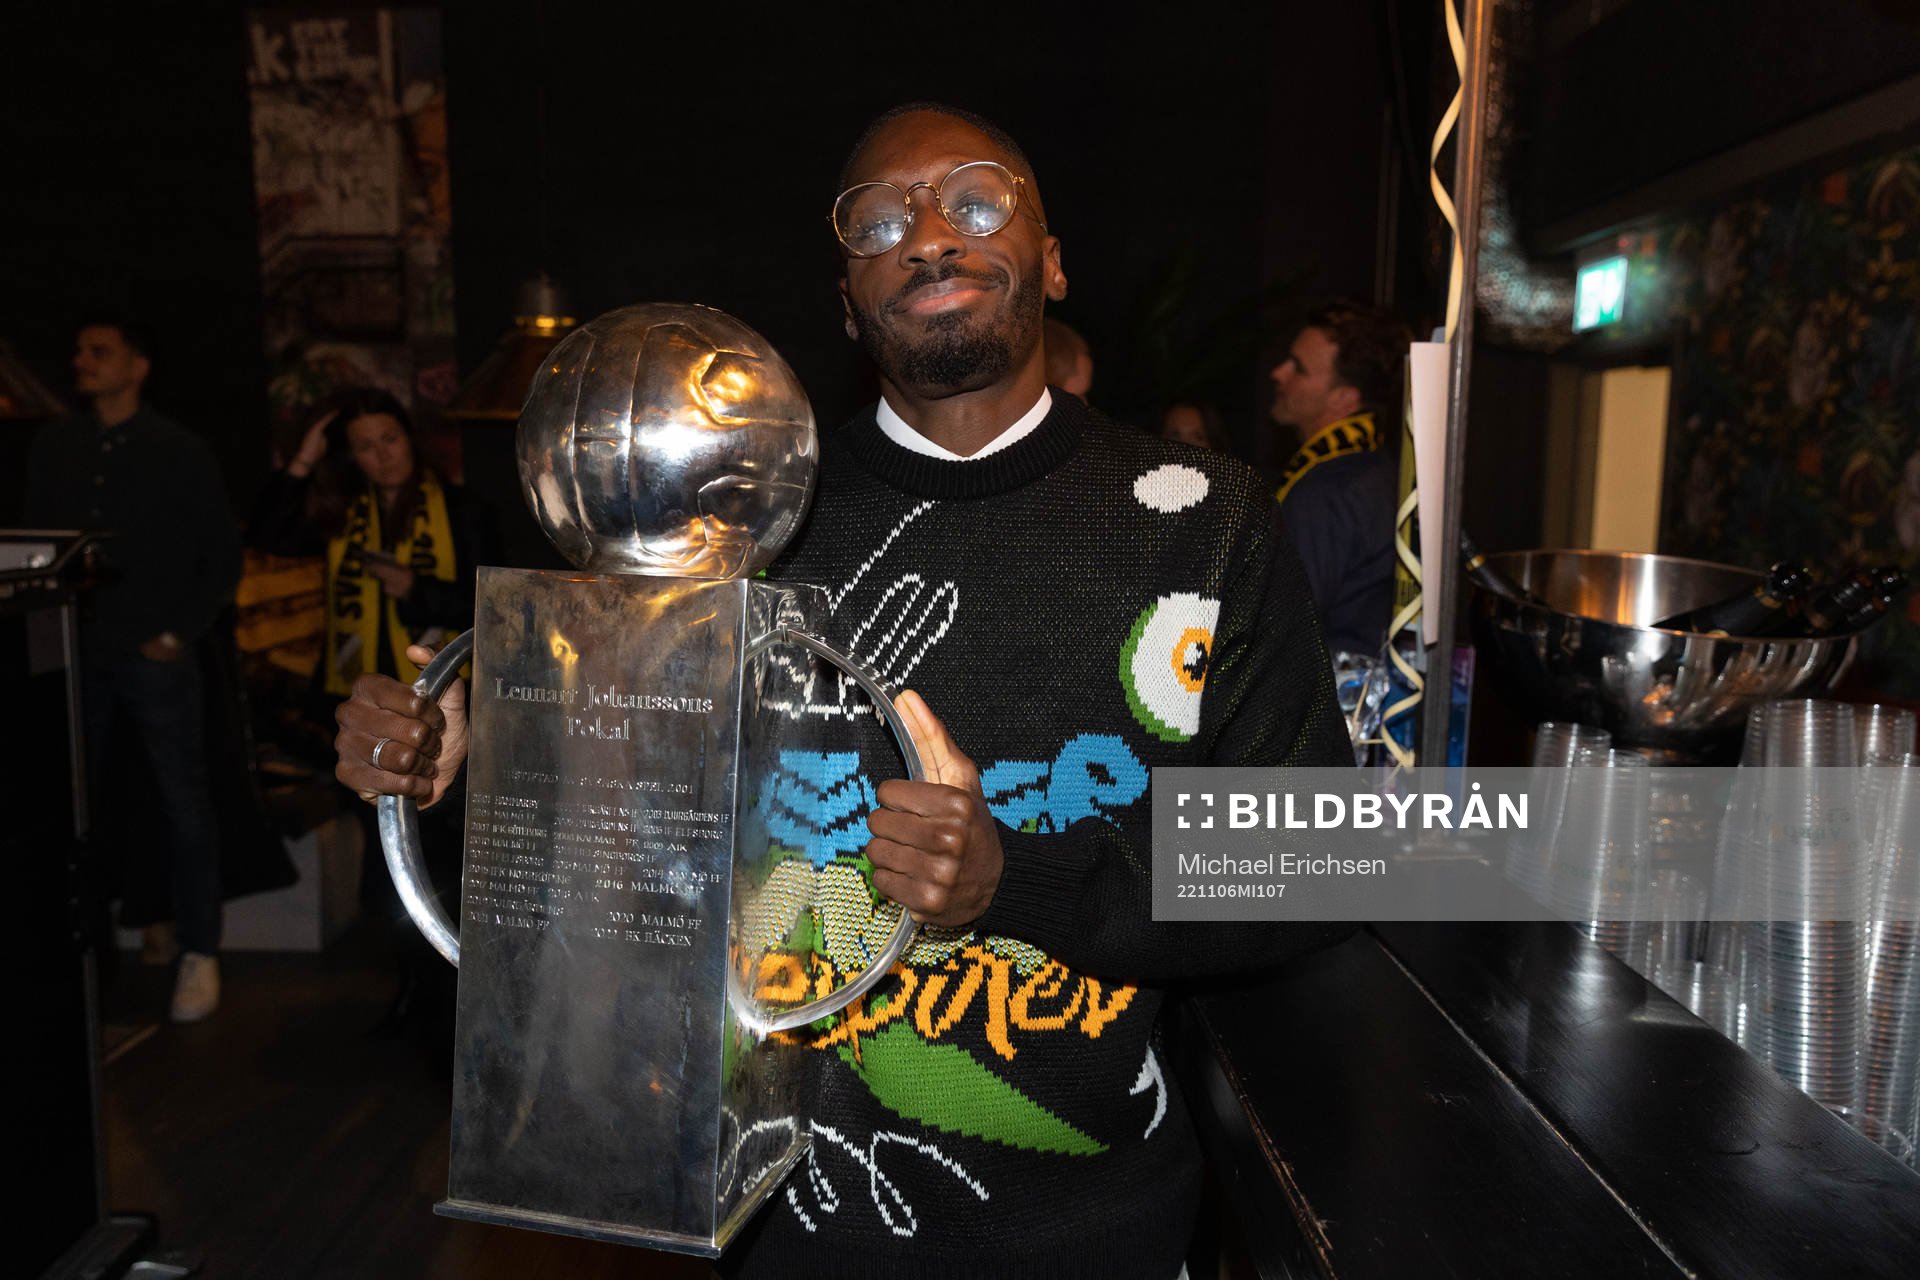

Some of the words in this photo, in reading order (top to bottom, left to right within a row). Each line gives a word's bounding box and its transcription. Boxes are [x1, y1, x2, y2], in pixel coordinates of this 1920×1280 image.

[494, 677, 578, 705] Lennart
[583, 683, 714, 714] Johanssons
[566, 715, 630, 741] Pokal
[667, 783, 694, 795] 2001
[667, 842, 688, 853] AIK
[595, 879, 623, 890] 2016
[496, 914, 534, 929] MALMÖ
[537, 919, 550, 931] FF
[644, 930, 692, 946] HÄCKEN
[641, 913, 685, 928] MALMÖ
[688, 918, 702, 930] FF
